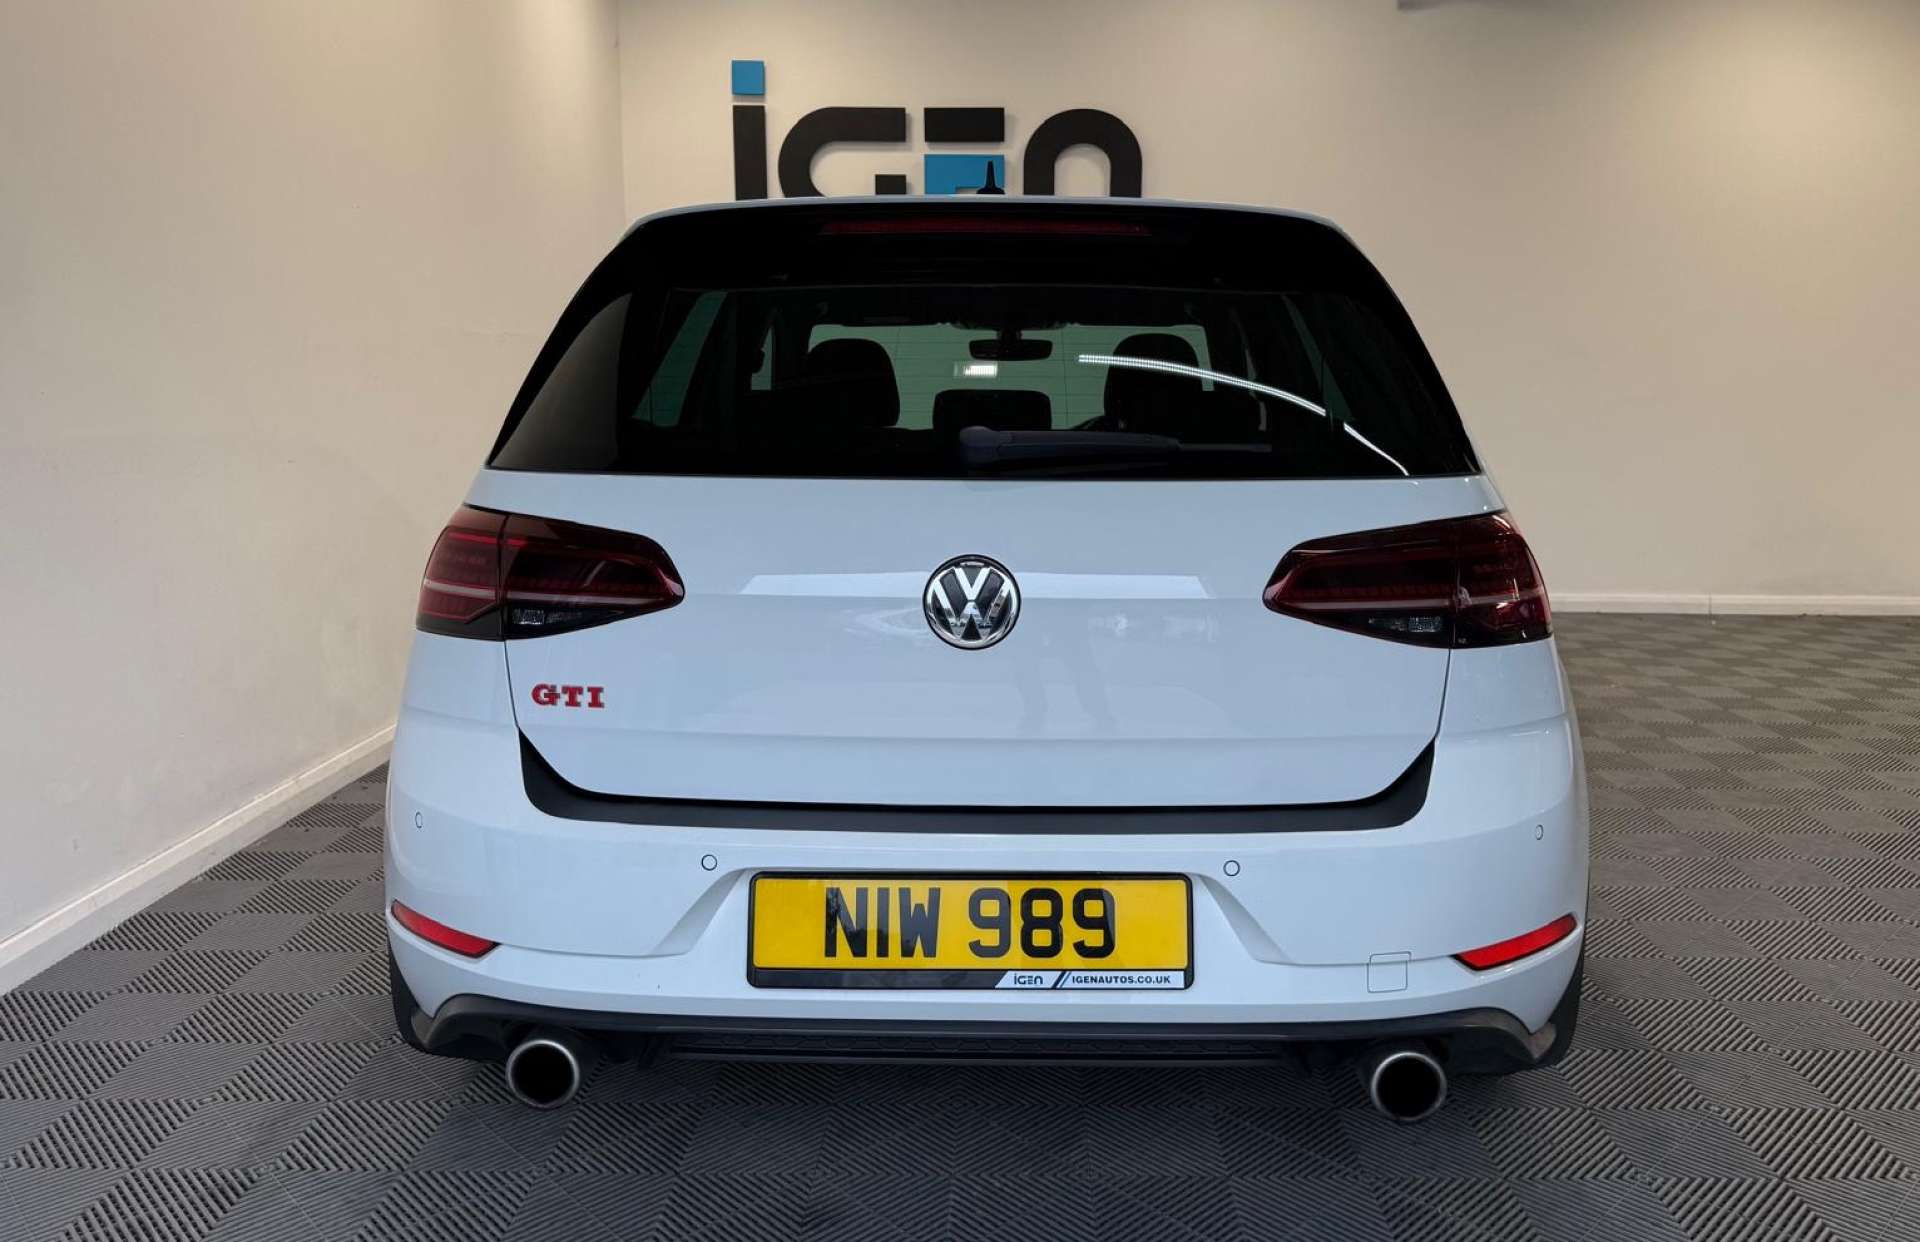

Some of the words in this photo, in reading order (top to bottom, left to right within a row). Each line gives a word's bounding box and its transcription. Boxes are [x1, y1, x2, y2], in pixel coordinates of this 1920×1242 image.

[531, 683, 605, 708] GTI
[824, 887, 941, 958] NIW
[968, 887, 1116, 959] 989
[1072, 975, 1171, 984] IGENAUTOS.CO.UK
